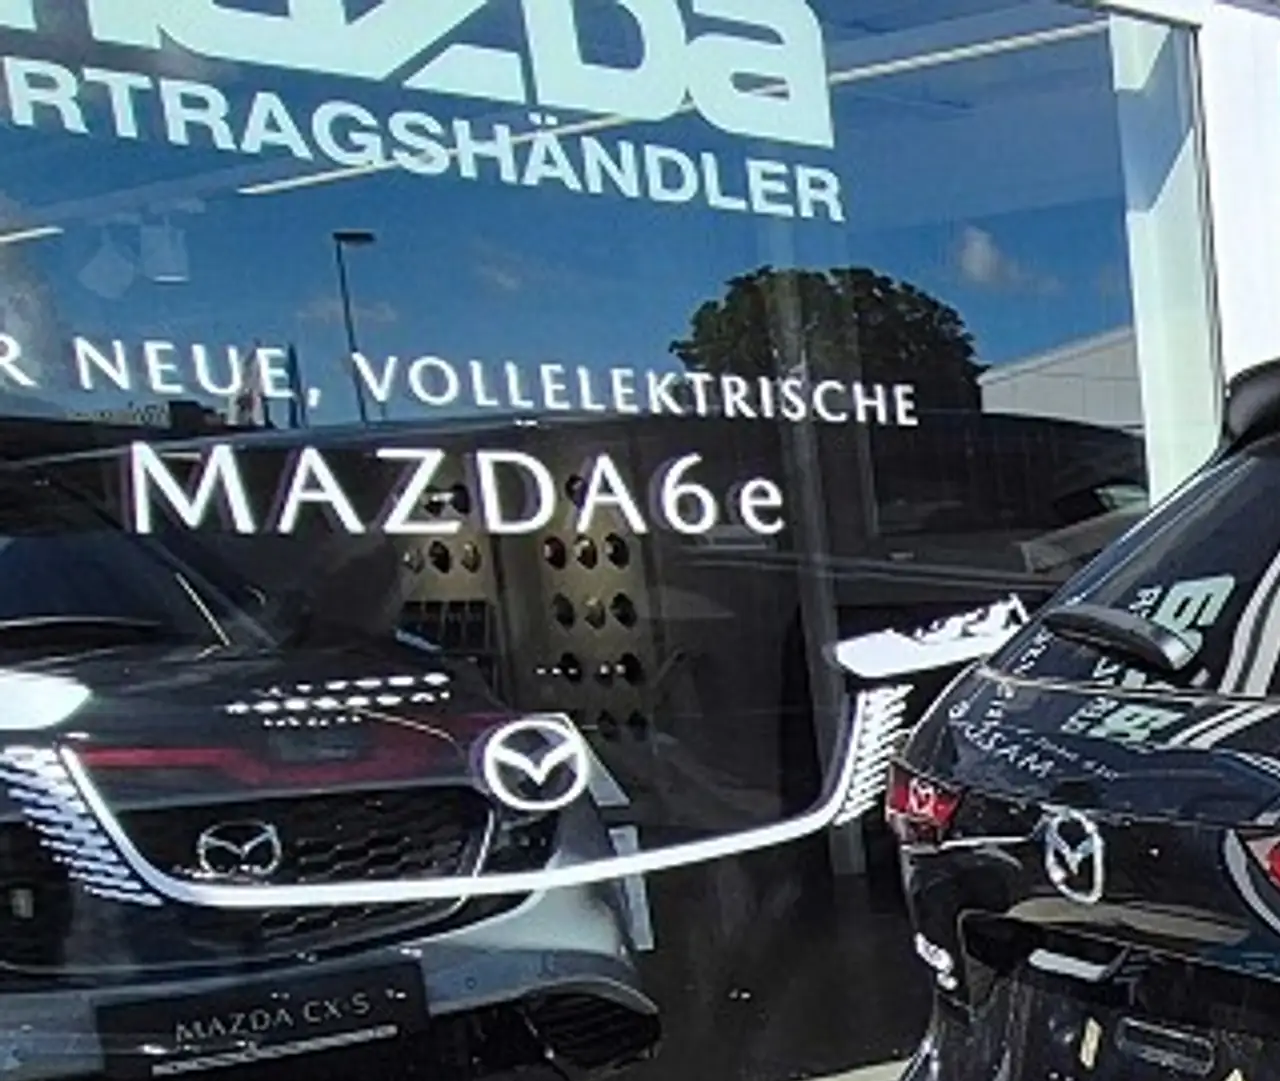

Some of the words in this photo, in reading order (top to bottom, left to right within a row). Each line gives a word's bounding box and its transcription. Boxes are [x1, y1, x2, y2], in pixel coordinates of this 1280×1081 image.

[73, 336, 320, 408] NEUE,
[351, 351, 919, 426] VOLLELEKTRISCHE
[131, 440, 786, 536] MAZDA6e
[175, 1008, 294, 1043] MAZDA
